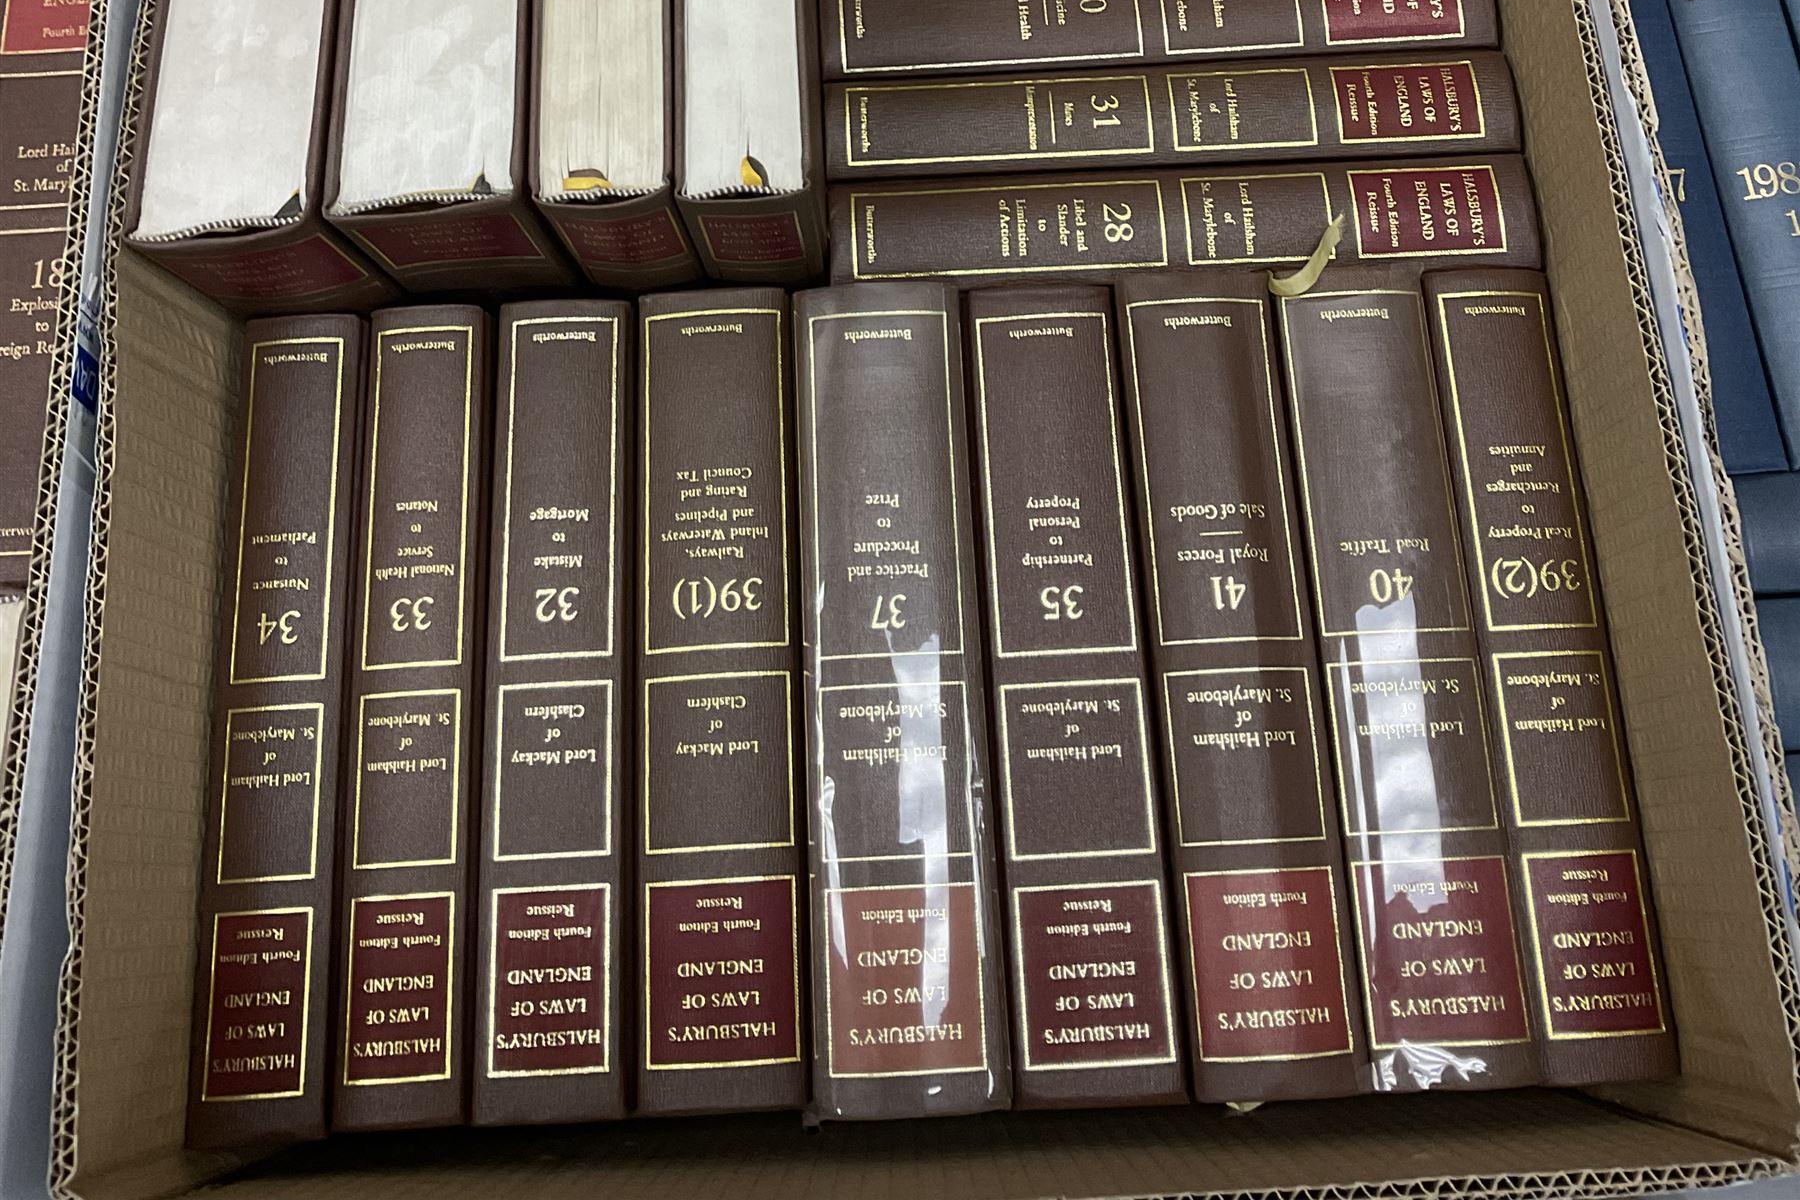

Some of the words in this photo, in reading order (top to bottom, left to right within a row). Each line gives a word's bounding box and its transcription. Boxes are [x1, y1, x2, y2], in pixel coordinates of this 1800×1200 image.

[1418, 77, 1434, 104] LAWS
[1394, 75, 1412, 127] ENGLAND
[1440, 68, 1462, 132] HALSBURY'S
[1091, 95, 1121, 129] 31
[1423, 107, 1436, 123] OF
[18, 145, 47, 159] Lord
[57, 159, 70, 172] of
[1737, 161, 1800, 201] 198
[999, 200, 1010, 210] of
[1439, 183, 1455, 215] LAWS
[1073, 199, 1085, 226] Libel
[1414, 181, 1434, 240] ENGLAND
[1461, 173, 1485, 246] HALSBURY'S
[1016, 199, 1028, 256] Limitation
[1038, 219, 1047, 231] to
[1057, 204, 1069, 246] Slander
[1102, 203, 1133, 242] 28
[1446, 218, 1459, 236] OF
[1000, 213, 1011, 256] Actions
[1077, 230, 1088, 252] and
[36, 321, 49, 331] to
[844, 328, 912, 342] Butterworths
[392, 341, 455, 353] Butterworths
[1488, 444, 1546, 457] Annuities
[676, 470, 699, 482] Tax
[703, 466, 752, 480] Council
[1510, 463, 1532, 475] and
[680, 488, 702, 500] and
[706, 484, 748, 498] Rating
[1486, 481, 1560, 494] Rentcharges
[396, 500, 438, 512] Notaries
[865, 494, 899, 507] Prize
[1026, 496, 1080, 509] Property
[529, 507, 589, 522] Mortgage
[674, 508, 728, 522] Pipelines
[732, 507, 754, 518] and
[1170, 504, 1217, 521] Goods
[1220, 503, 1236, 519] of
[1240, 504, 1265, 518] Sale
[1522, 504, 1534, 515] to
[410, 523, 421, 534] to
[877, 518, 891, 529] to
[1028, 516, 1080, 530] Personal
[552, 532, 566, 543] to
[661, 527, 726, 543] Waterways
[730, 526, 768, 538] Inland
[1488, 525, 1541, 540] Property
[1545, 526, 1572, 539] Real
[853, 540, 920, 555] Procedure
[1049, 536, 1062, 547] to
[1340, 539, 1390, 555] Traffic
[1396, 538, 1429, 553] Road
[397, 546, 433, 558] Service
[1177, 549, 1224, 564] Forces
[1229, 543, 1268, 563] Royal
[275, 556, 288, 566] to
[533, 555, 583, 568] Mistake
[1022, 553, 1093, 567] Partnership
[375, 566, 407, 579] Health
[410, 564, 454, 577] National
[848, 566, 872, 581] and
[876, 563, 928, 578] Practice
[1491, 556, 1580, 599] 39(2)
[252, 578, 309, 591] Nuisance
[1369, 568, 1413, 602] 40
[672, 576, 763, 619] 39(1)
[1210, 576, 1246, 610] 41
[535, 586, 580, 622] 32
[1040, 585, 1084, 620] 35
[390, 596, 434, 631] 33
[871, 593, 907, 629] 37
[257, 610, 301, 645] 34
[687, 695, 746, 709] Clashfern
[1187, 685, 1271, 705] Marylebone
[1275, 688, 1291, 703] St.
[709, 719, 723, 732] of
[1235, 710, 1252, 727] of
[1193, 732, 1260, 749] Hailsham
[1265, 731, 1295, 746] Lord
[676, 739, 724, 756] Mackay
[728, 740, 758, 753] Lord
[677, 959, 763, 977] ENGLAND
[363, 975, 434, 992] ENGLAND
[682, 993, 705, 1008] OF
[711, 991, 760, 1007] LAWS
[1552, 992, 1652, 1012] HALSBURY'S
[389, 1006, 429, 1022] LAWS
[1390, 996, 1505, 1018] HALSBURY'S
[366, 1010, 384, 1024] OF
[1218, 1007, 1329, 1030] HALSBURY'S
[496, 1028, 600, 1049] HALSBURY'S
[668, 1022, 776, 1041] HALSBURY'S
[850, 1023, 962, 1046] HALSBURY'S
[1044, 1023, 1150, 1044] HALSBURY'S
[353, 1038, 440, 1057] HALSBURY'S
[212, 1054, 295, 1072] HALSBURY'S
